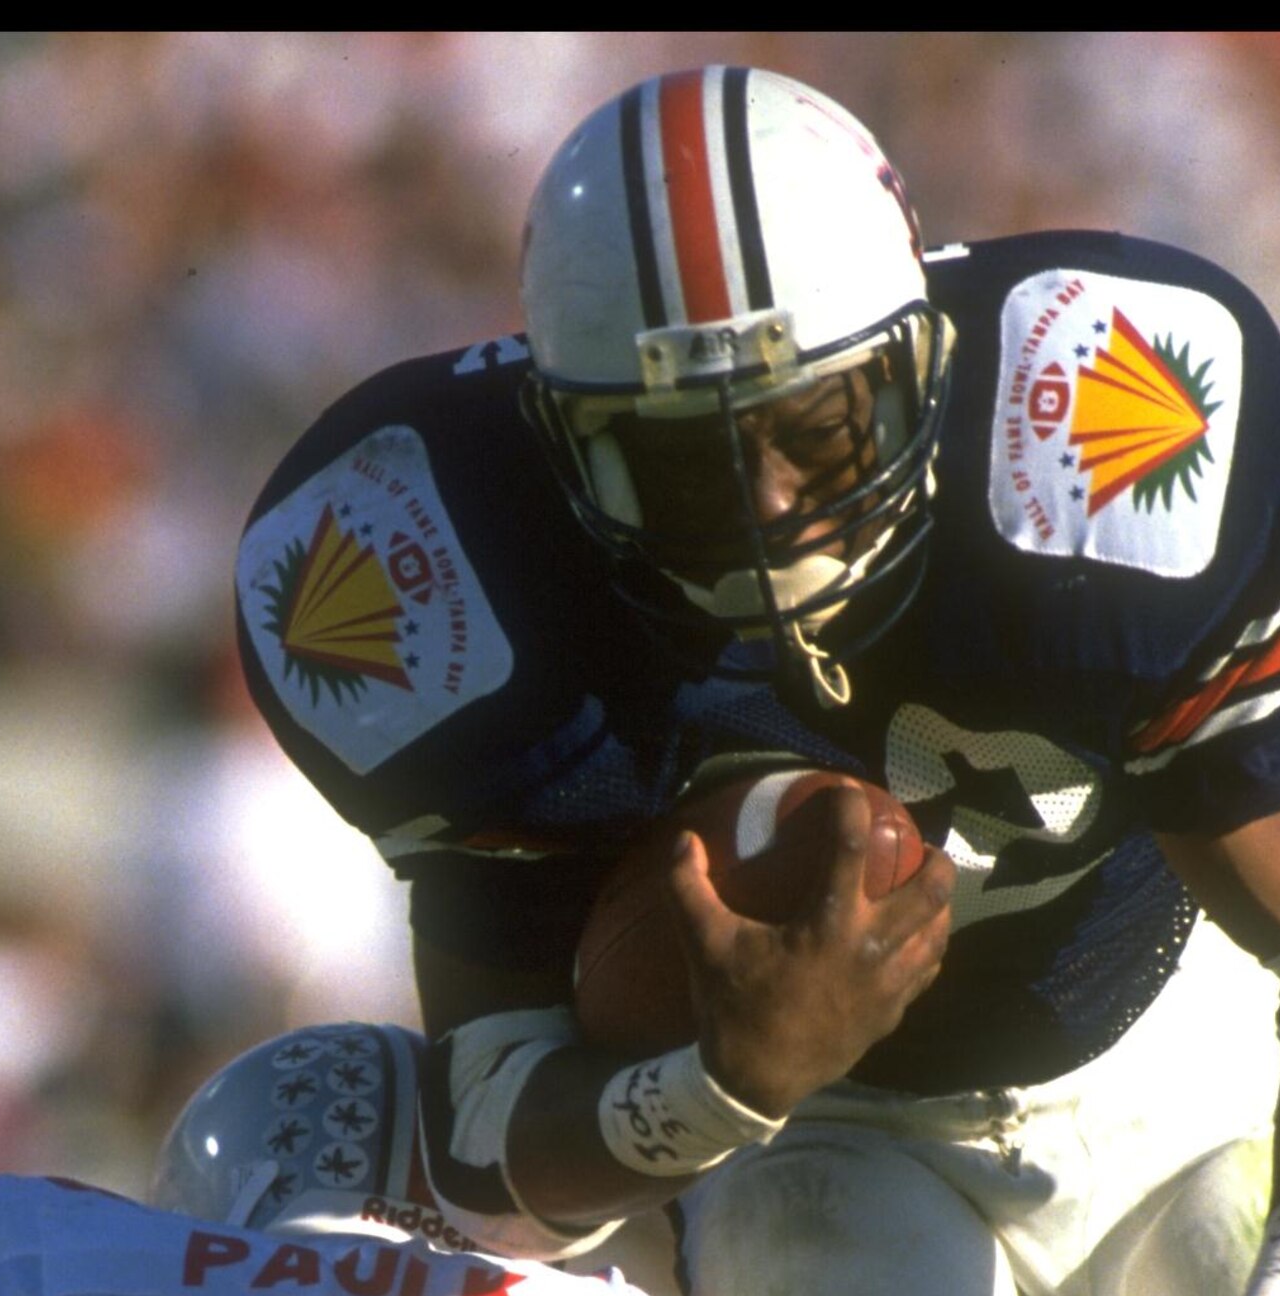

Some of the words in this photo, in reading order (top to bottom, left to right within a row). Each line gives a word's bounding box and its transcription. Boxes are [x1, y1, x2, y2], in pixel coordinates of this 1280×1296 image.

[1056, 279, 1086, 306] BAY
[1006, 417, 1023, 462] FAME
[1011, 471, 1031, 492] OF
[1024, 497, 1055, 541] HALL
[351, 455, 386, 484] HALL
[387, 478, 408, 497] OF
[404, 498, 438, 539] FAME
[443, 661, 465, 695] BAY
